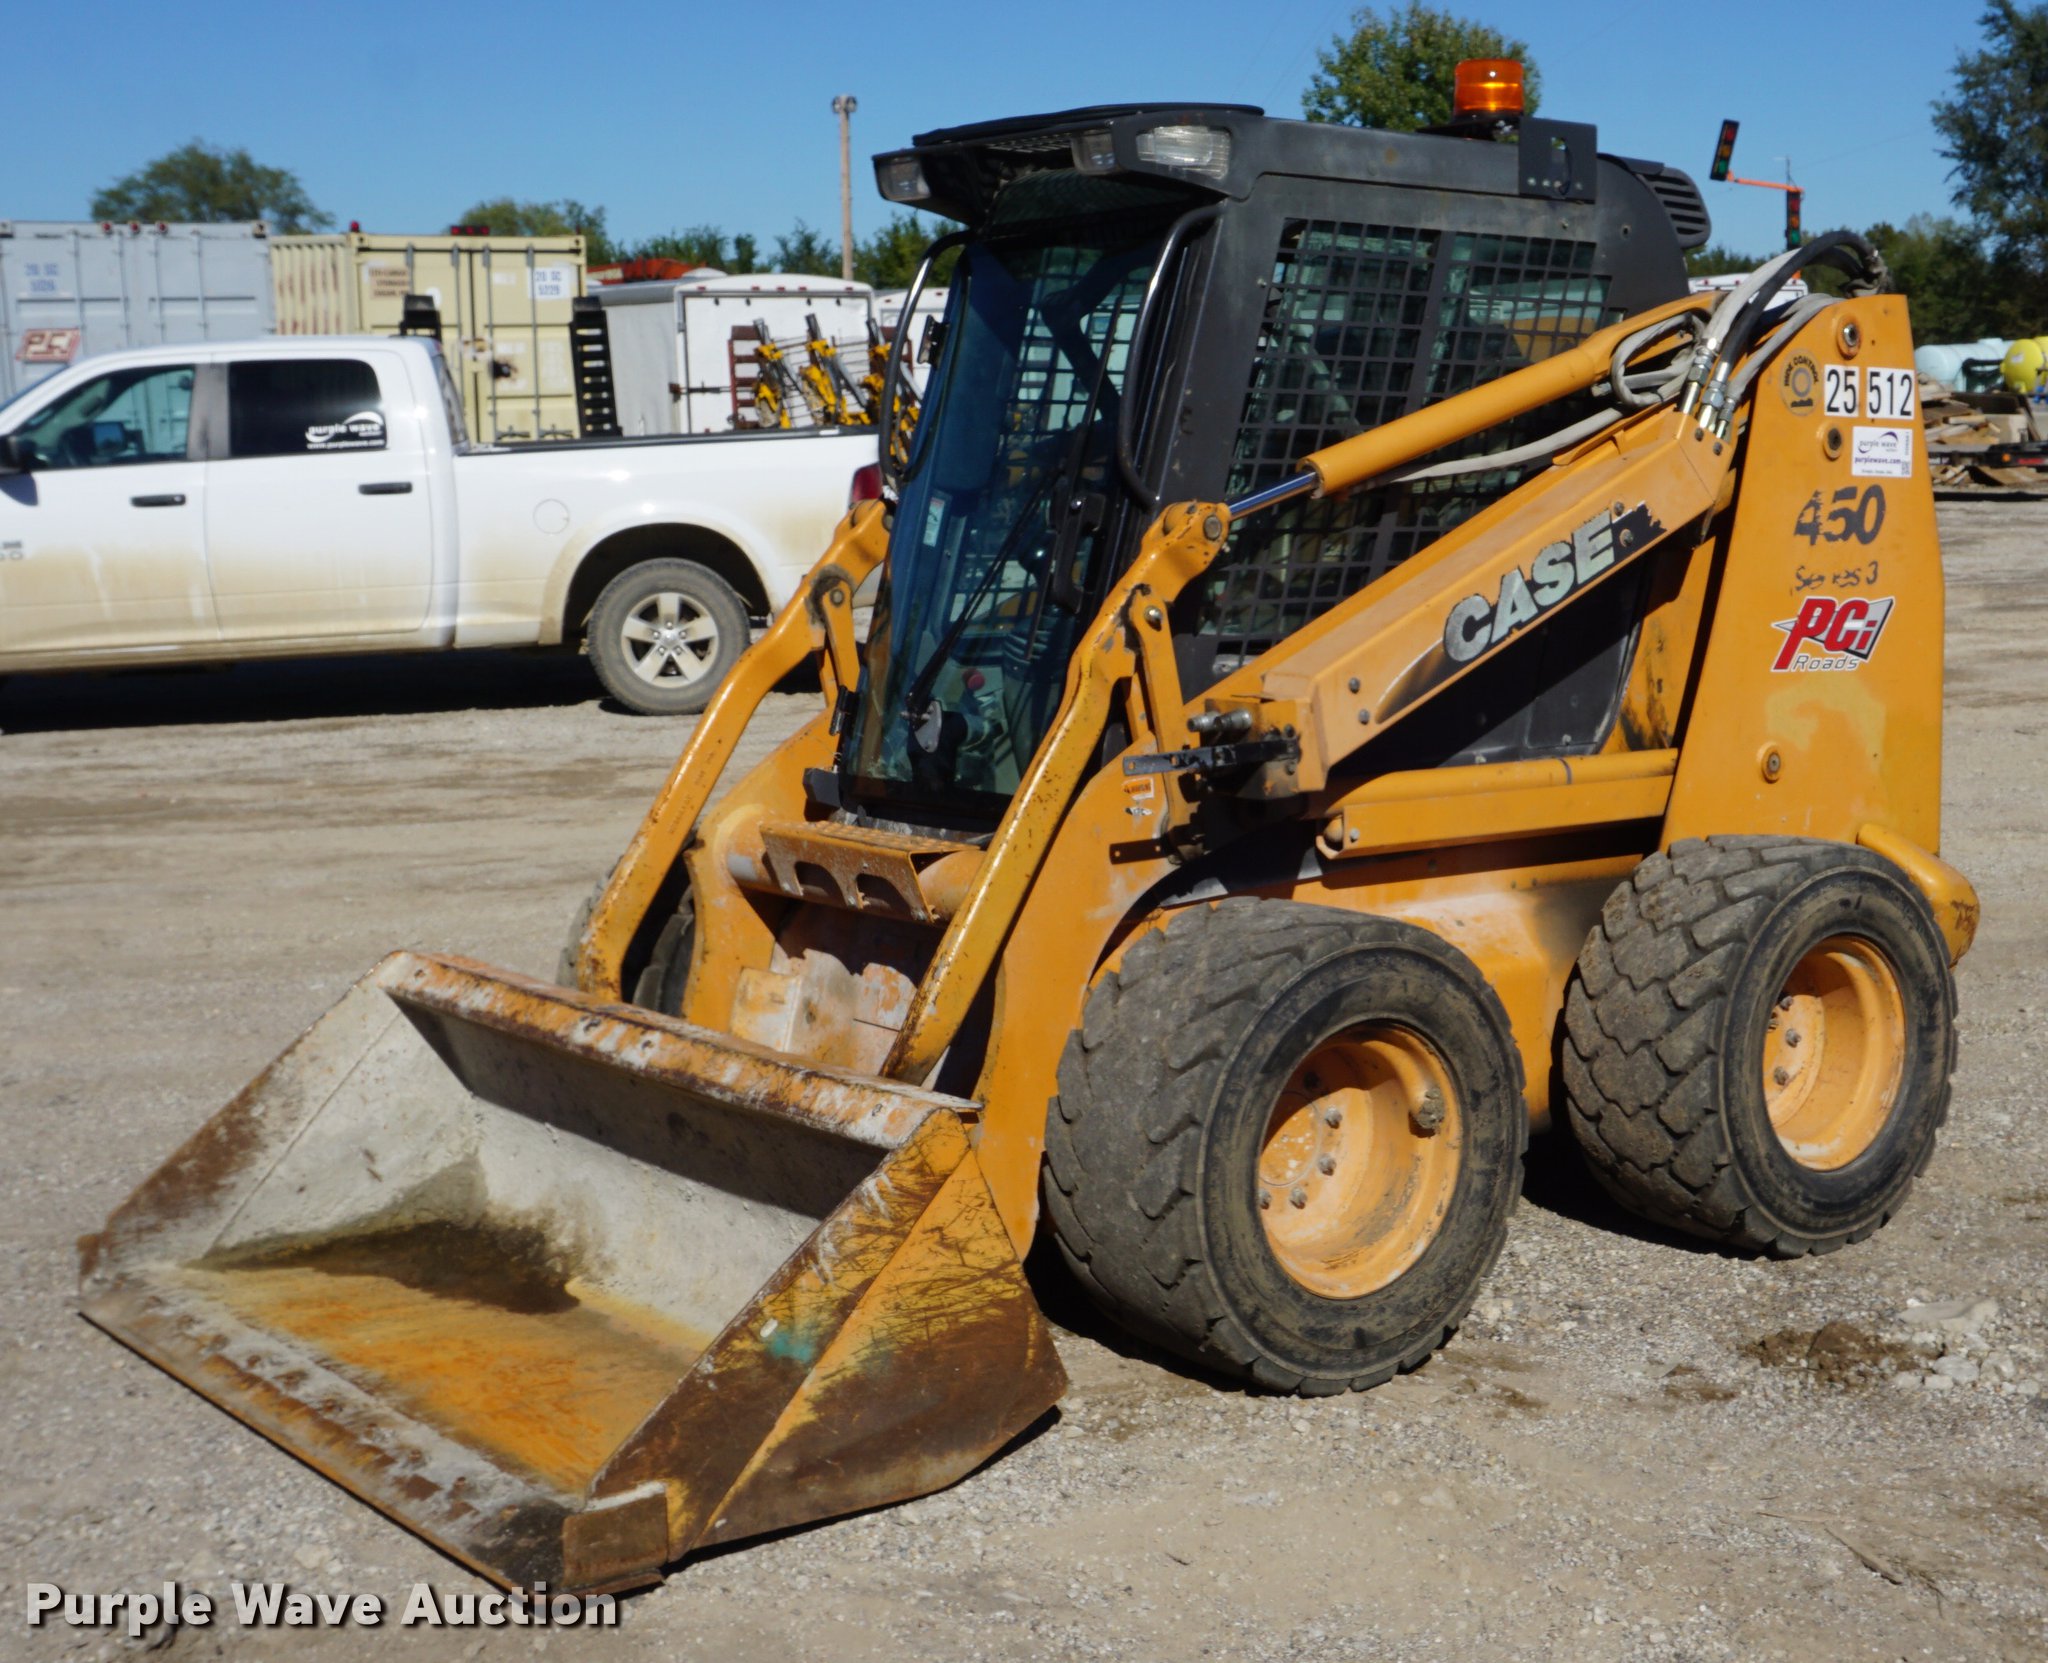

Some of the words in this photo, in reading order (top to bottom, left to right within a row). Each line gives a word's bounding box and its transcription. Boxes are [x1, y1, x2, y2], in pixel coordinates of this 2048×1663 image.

[1825, 368, 1858, 414] 25
[1868, 371, 1914, 417] 512
[1860, 440, 1879, 448] purple
[1793, 484, 1887, 546] 450
[1443, 508, 1616, 663] CASE
[1795, 565, 1862, 591] Sees
[1866, 561, 1879, 585] 3
[1793, 653, 1861, 672] Roads
